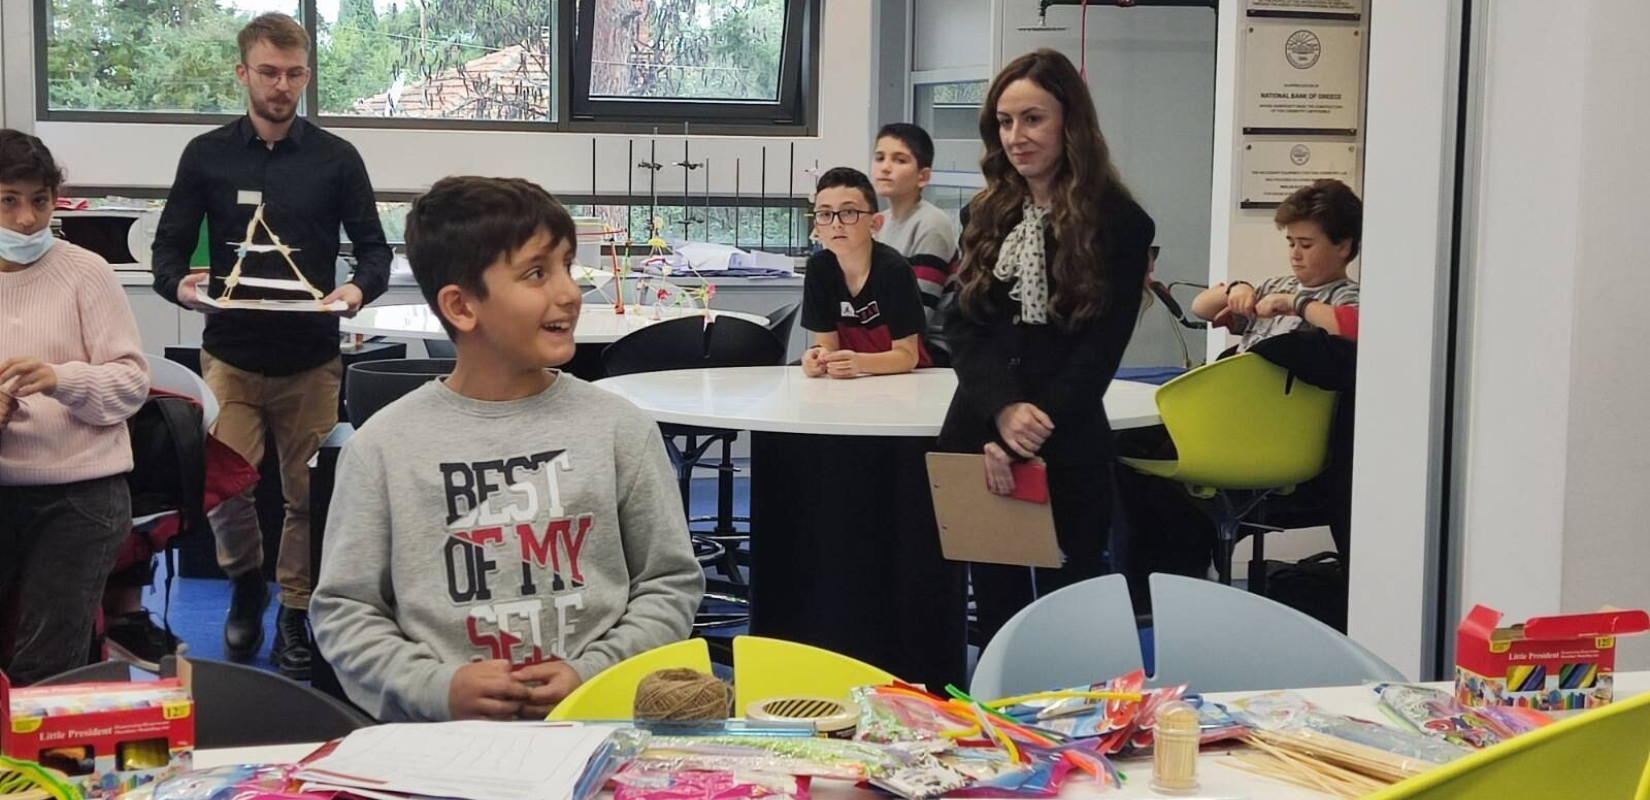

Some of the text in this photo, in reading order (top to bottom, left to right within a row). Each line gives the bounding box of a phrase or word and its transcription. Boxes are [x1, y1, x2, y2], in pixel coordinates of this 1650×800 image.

[440, 449, 573, 526] BEST
[443, 514, 593, 602] OF MY
[1529, 651, 1560, 660] President
[39, 731, 66, 741] Little
[68, 727, 113, 738] President
